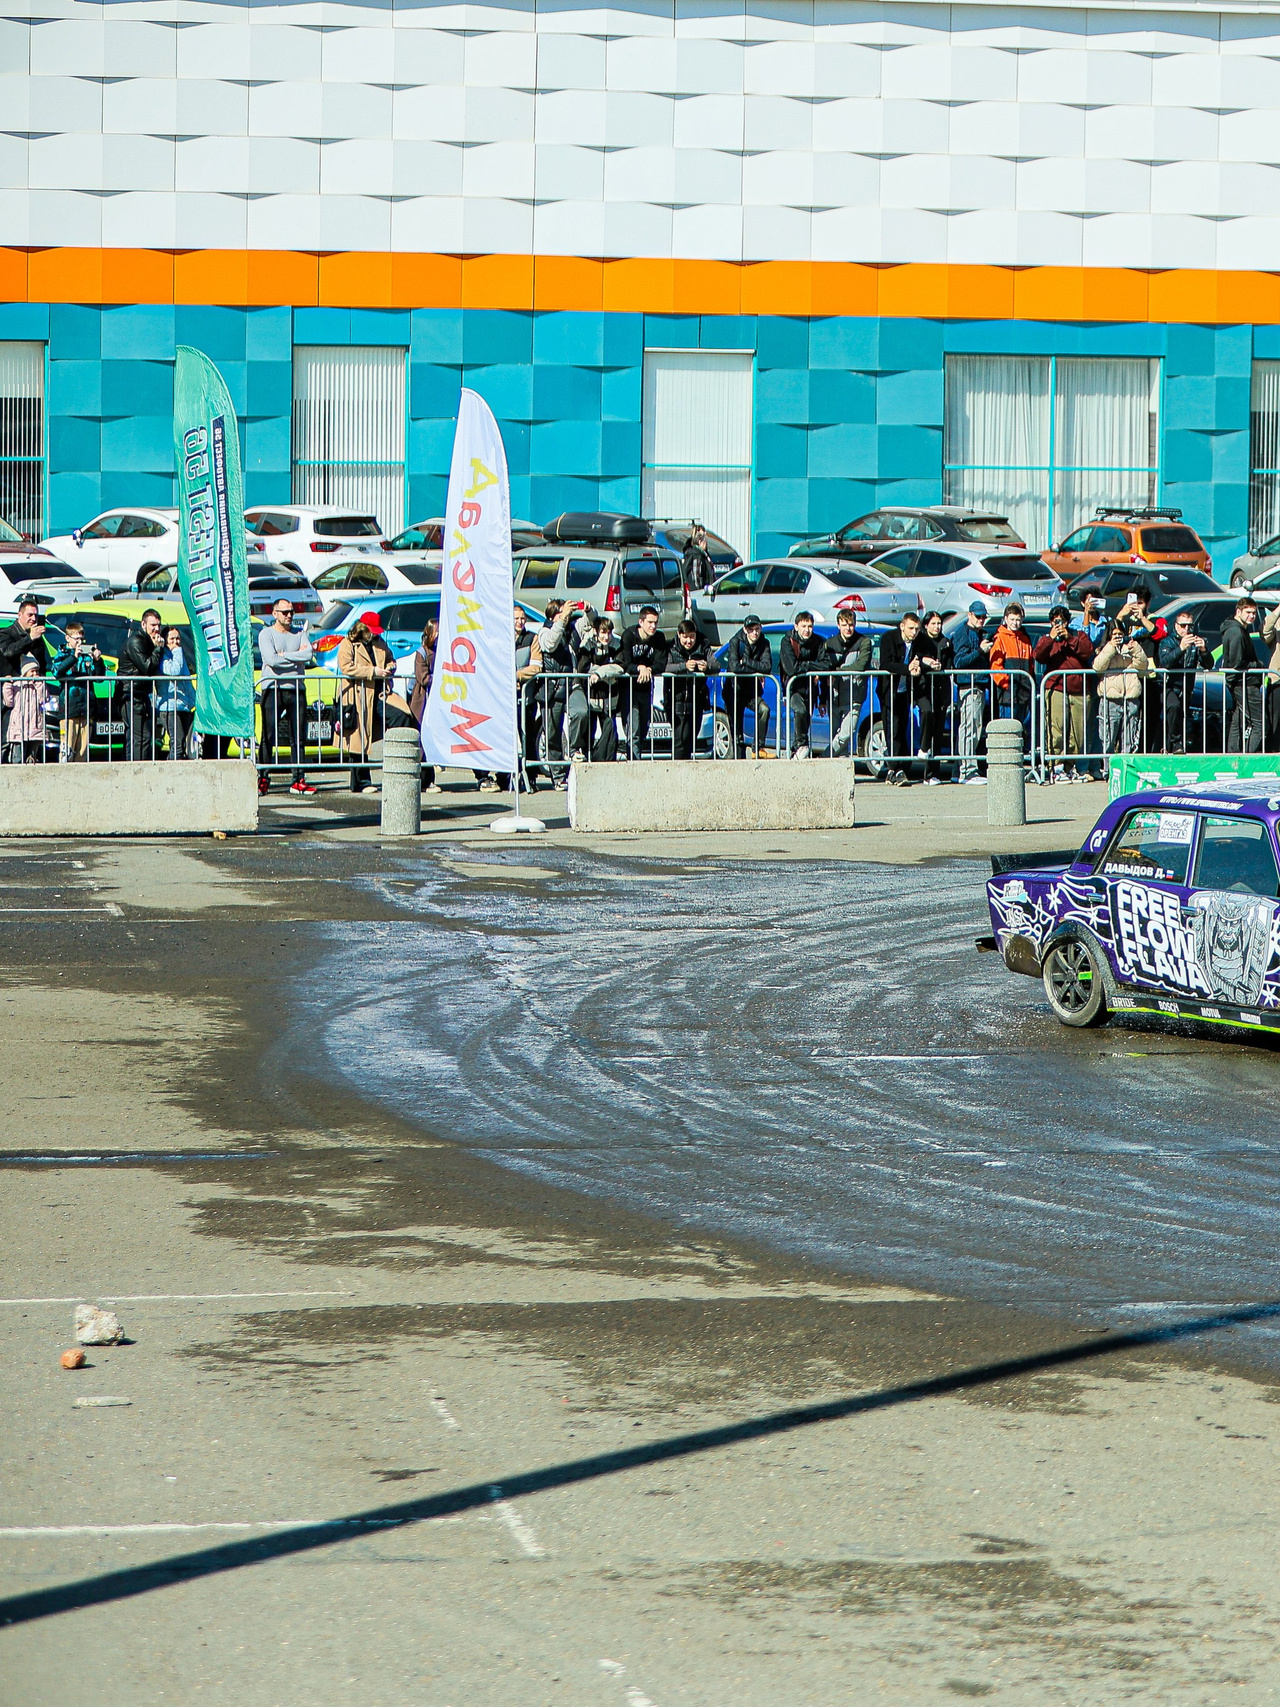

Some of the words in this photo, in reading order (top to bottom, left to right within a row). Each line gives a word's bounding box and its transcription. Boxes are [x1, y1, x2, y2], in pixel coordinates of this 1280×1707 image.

[1103, 862, 1153, 878] ДАВЫДОВ
[1154, 867, 1166, 880] Д.
[1117, 883, 1181, 930] FREE
[1117, 908, 1198, 964] FLOW
[1122, 937, 1211, 995] FLAVA
[1111, 996, 1137, 1008] BRIDE
[1158, 1001, 1179, 1014] BOSCH
[1201, 1007, 1221, 1019] MOTUL
